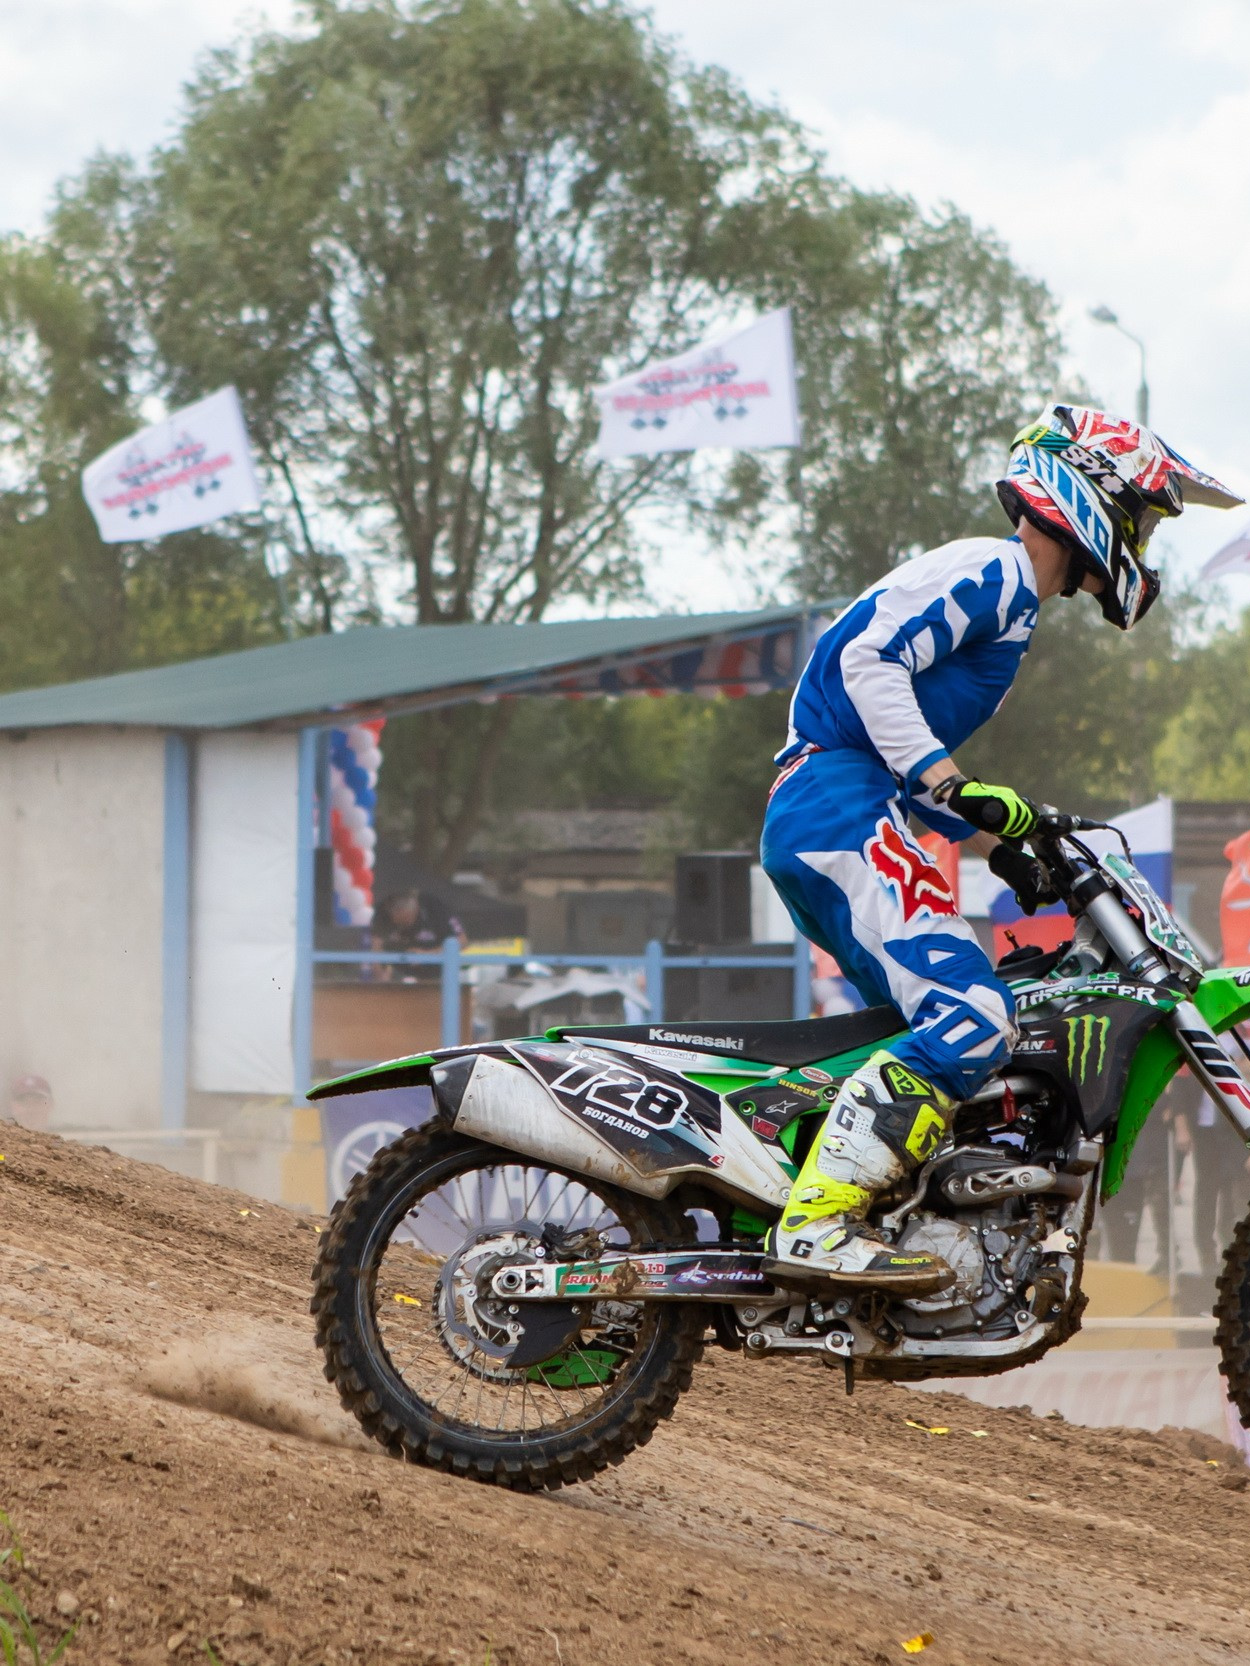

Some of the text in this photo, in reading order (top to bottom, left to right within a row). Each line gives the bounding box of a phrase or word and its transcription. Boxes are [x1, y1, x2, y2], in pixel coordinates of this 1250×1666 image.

[649, 1028, 744, 1051] Kawasaki
[645, 1046, 698, 1062] Kawasaki
[550, 1050, 689, 1130] 728
[895, 1073, 916, 1094] 12
[582, 1105, 650, 1140] БОГДАНОВ
